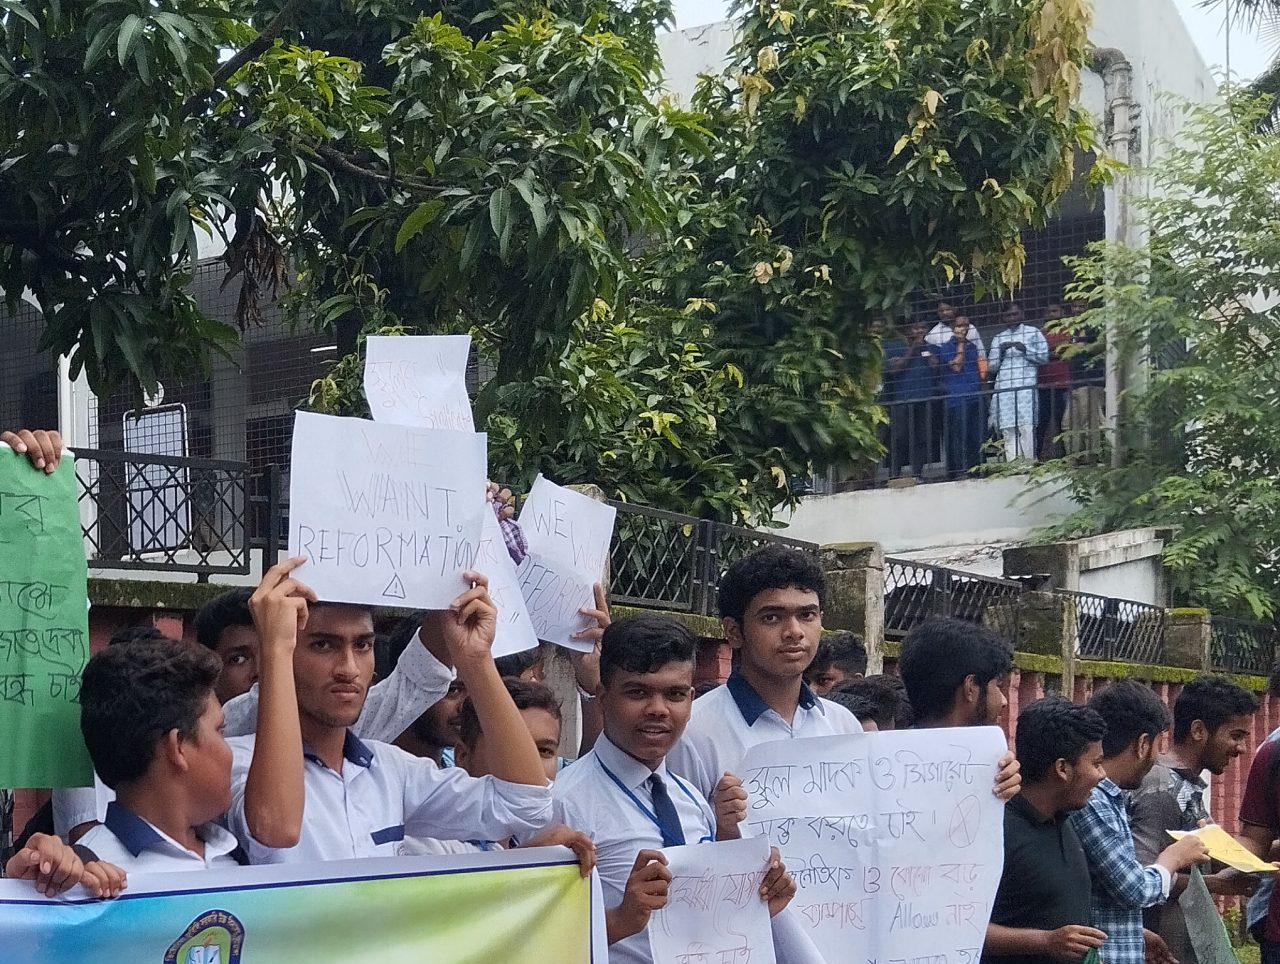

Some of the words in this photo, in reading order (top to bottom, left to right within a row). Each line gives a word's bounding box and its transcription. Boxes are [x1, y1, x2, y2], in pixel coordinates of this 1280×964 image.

[361, 428, 433, 468] WE
[336, 468, 457, 527] WANT
[532, 494, 568, 538] WE
[518, 553, 593, 624] EFORM
[803, 758, 864, 794] মাদক
[867, 756, 895, 790] ও
[863, 866, 881, 894] ও
